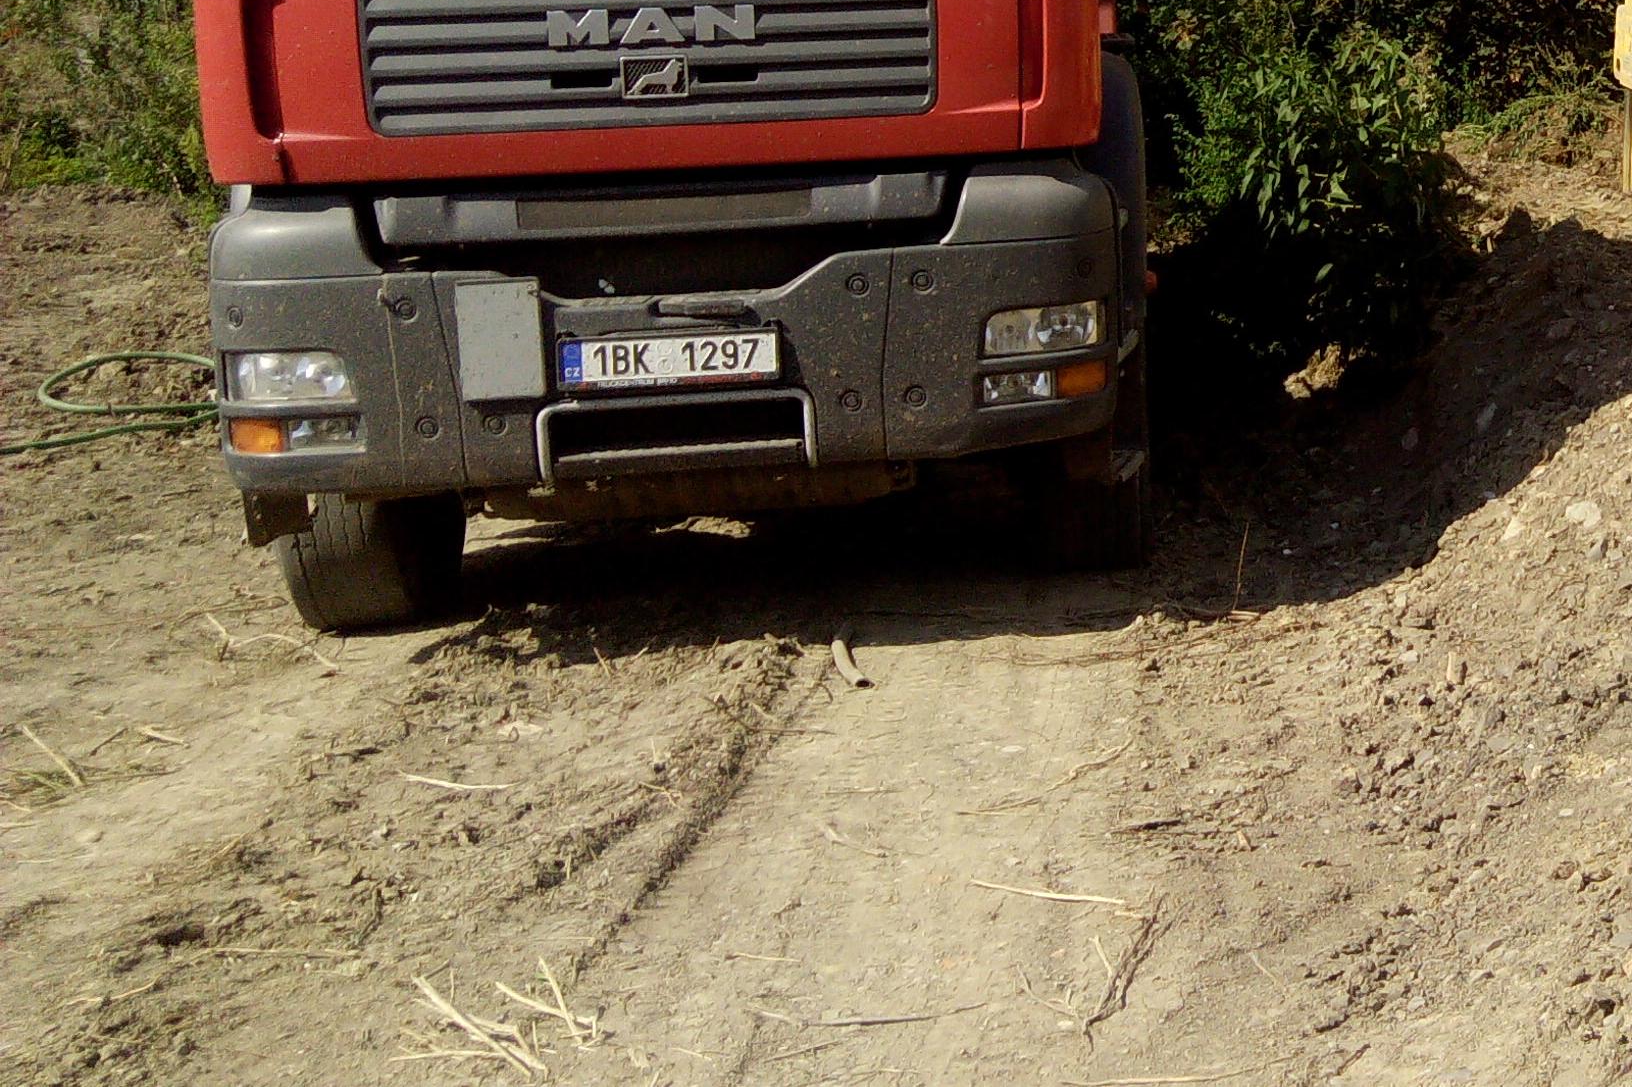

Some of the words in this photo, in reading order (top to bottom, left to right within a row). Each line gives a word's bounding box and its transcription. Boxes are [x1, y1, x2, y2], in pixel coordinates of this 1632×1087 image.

[546, 4, 756, 47] MAN
[564, 367, 580, 378] CZ
[593, 343, 651, 376] 1BK
[681, 338, 760, 371] 1297
